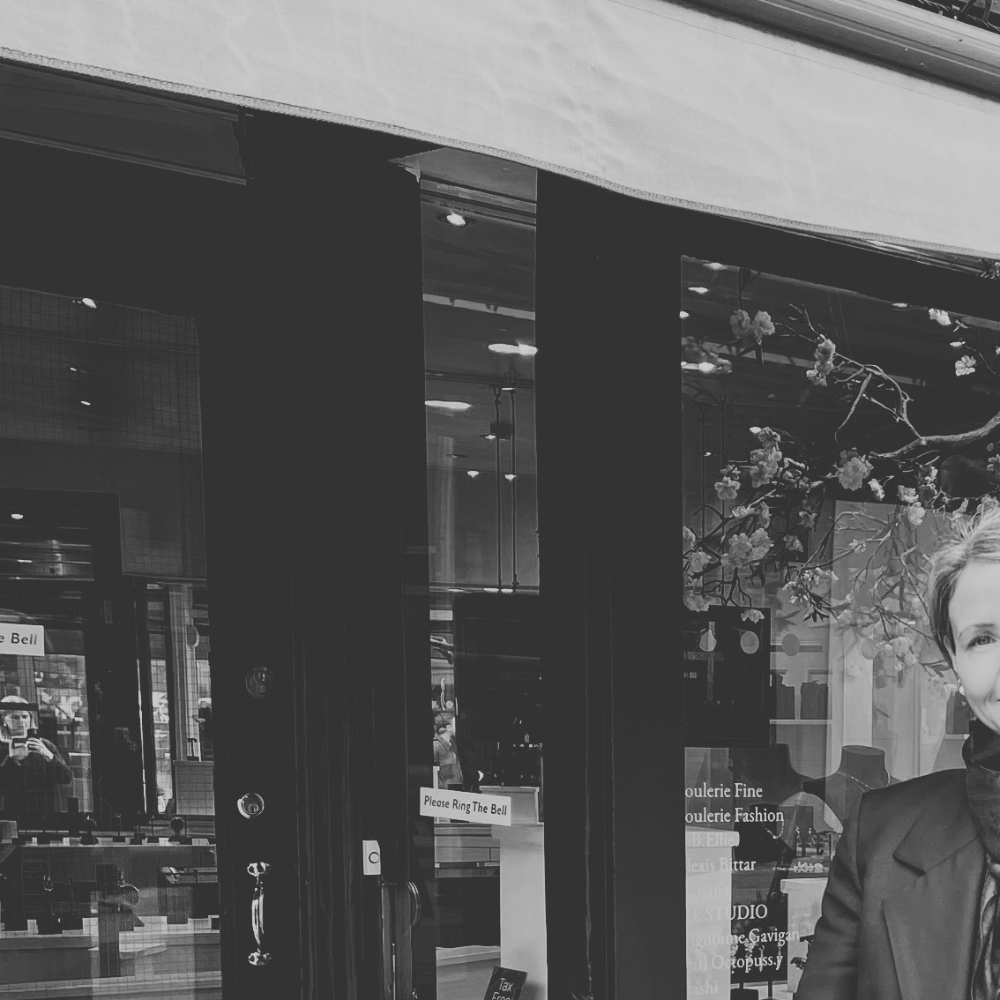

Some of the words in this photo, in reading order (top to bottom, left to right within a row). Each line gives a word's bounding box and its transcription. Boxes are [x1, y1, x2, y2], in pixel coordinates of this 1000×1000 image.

[11, 632, 38, 645] Bell
[685, 782, 731, 798] oulerie
[734, 782, 763, 798] Fine
[424, 795, 450, 809] Please
[452, 798, 471, 815] Ring
[472, 800, 488, 814] The
[490, 803, 507, 816] Bell
[685, 807, 731, 823] oulerie
[734, 806, 785, 823] Fashion
[687, 857, 716, 873] lexis
[719, 857, 757, 872] Bittar
[704, 904, 769, 921] STUDIO
[690, 934, 746, 951] ignonne
[748, 928, 800, 947] Gavigan
[498, 977, 514, 992] Tax
[689, 979, 718, 995] ashi
